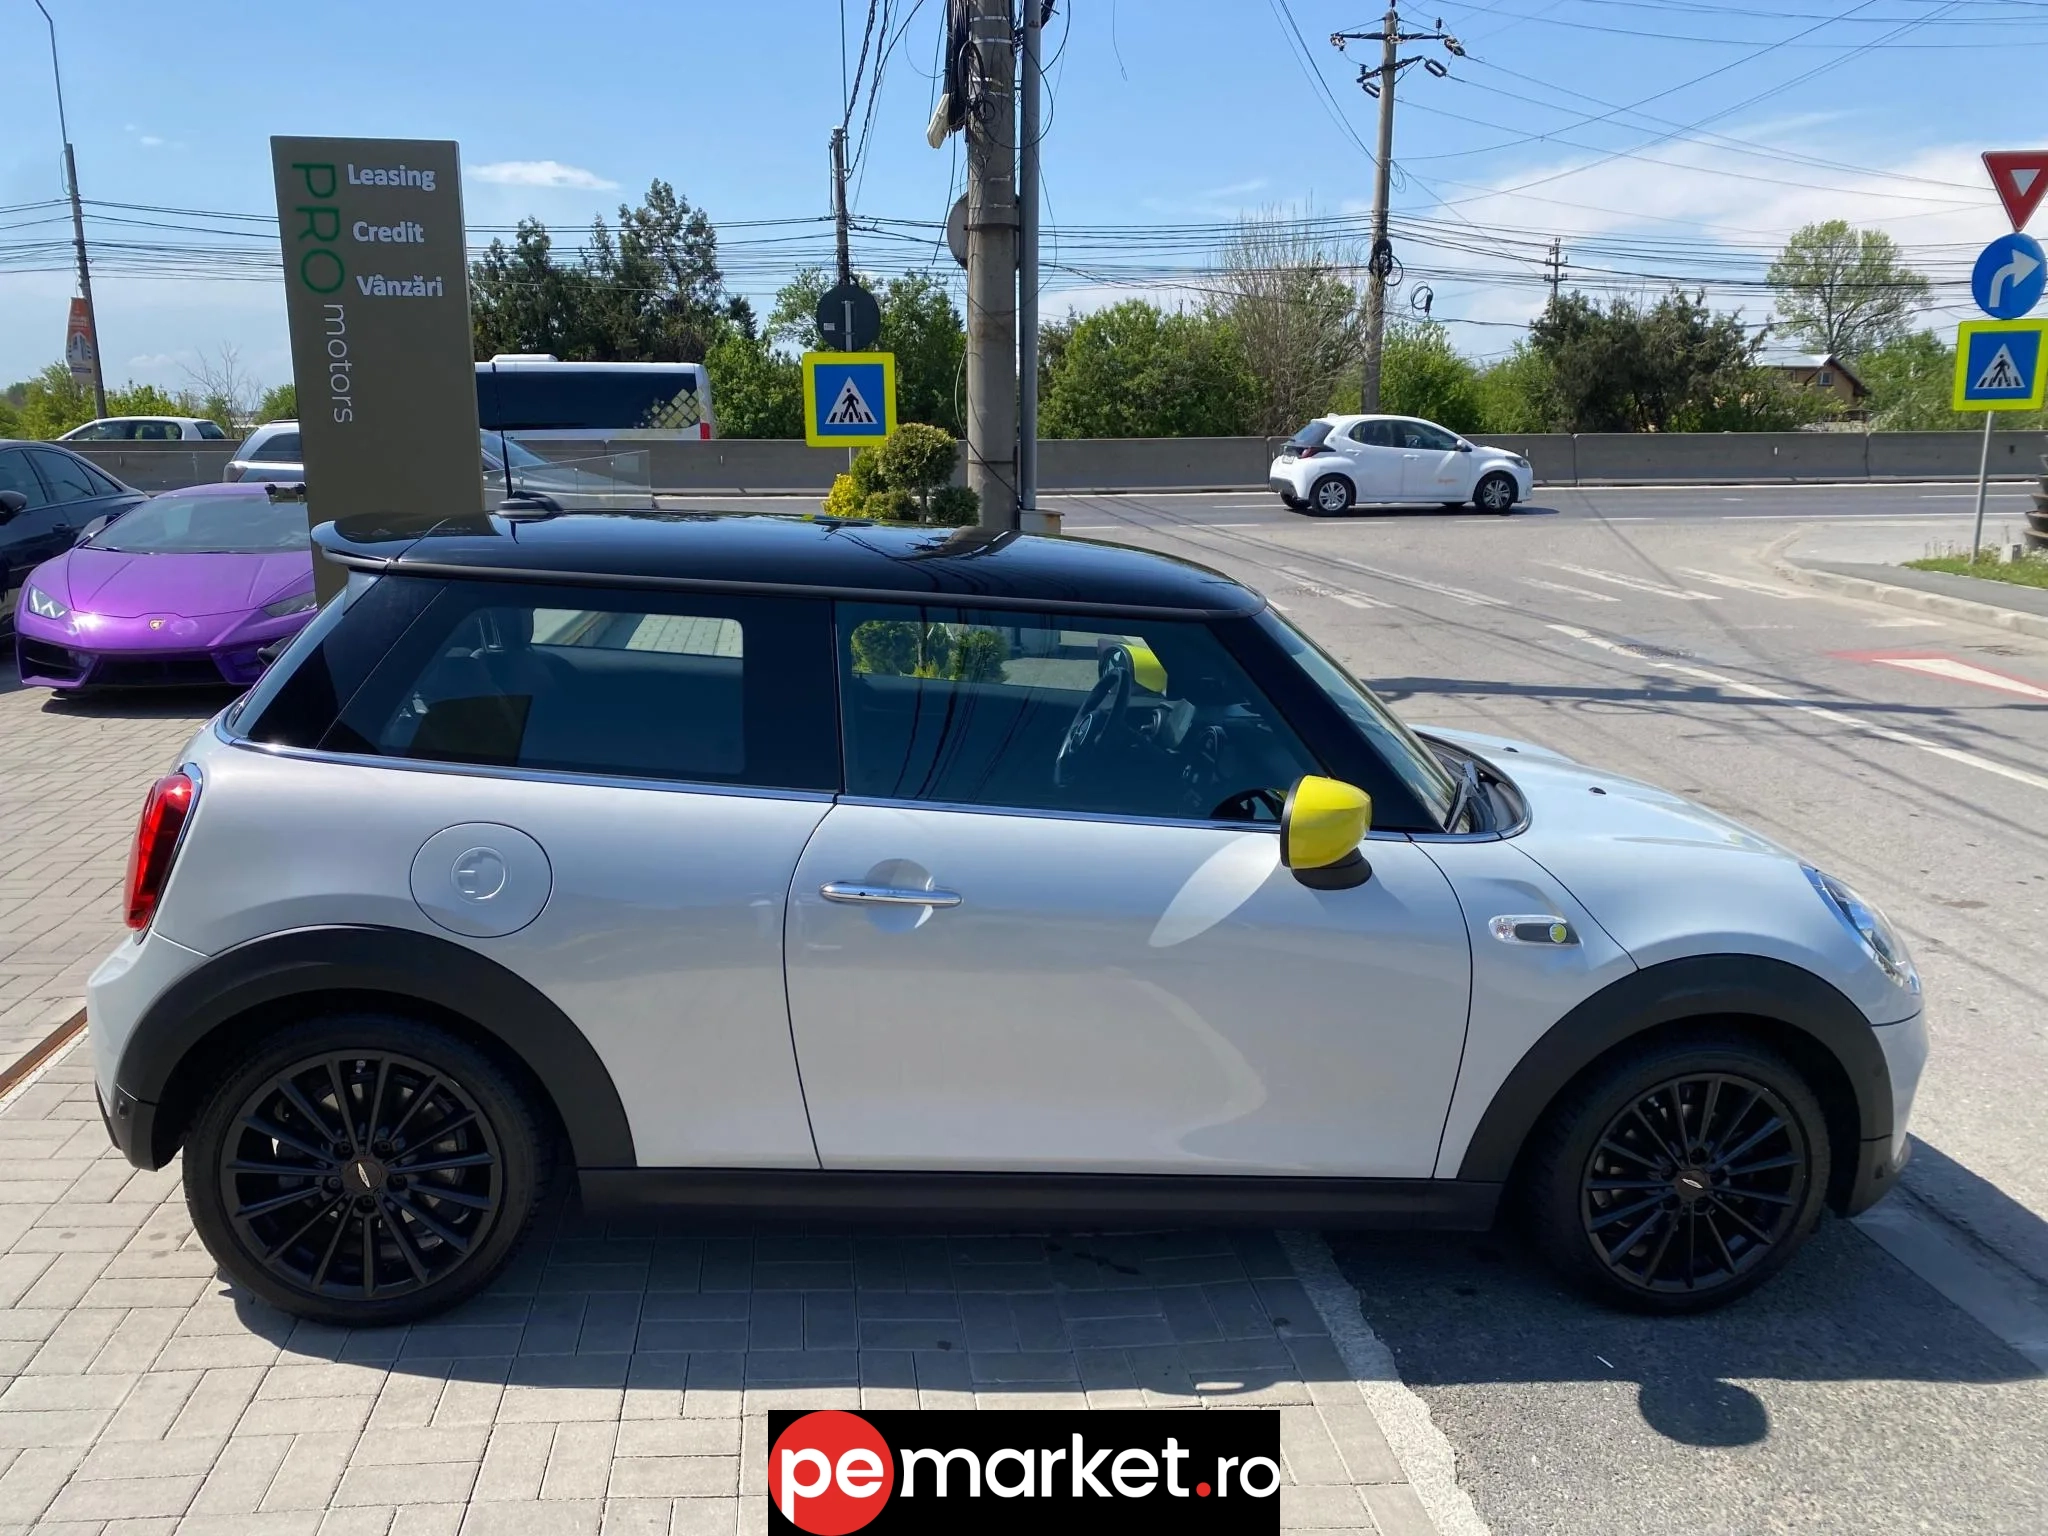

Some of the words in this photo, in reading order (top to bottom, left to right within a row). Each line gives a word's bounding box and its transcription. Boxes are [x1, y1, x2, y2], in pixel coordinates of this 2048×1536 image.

[347, 163, 436, 192] Leasing
[352, 221, 425, 243] Credit
[356, 273, 443, 297] Vânzări
